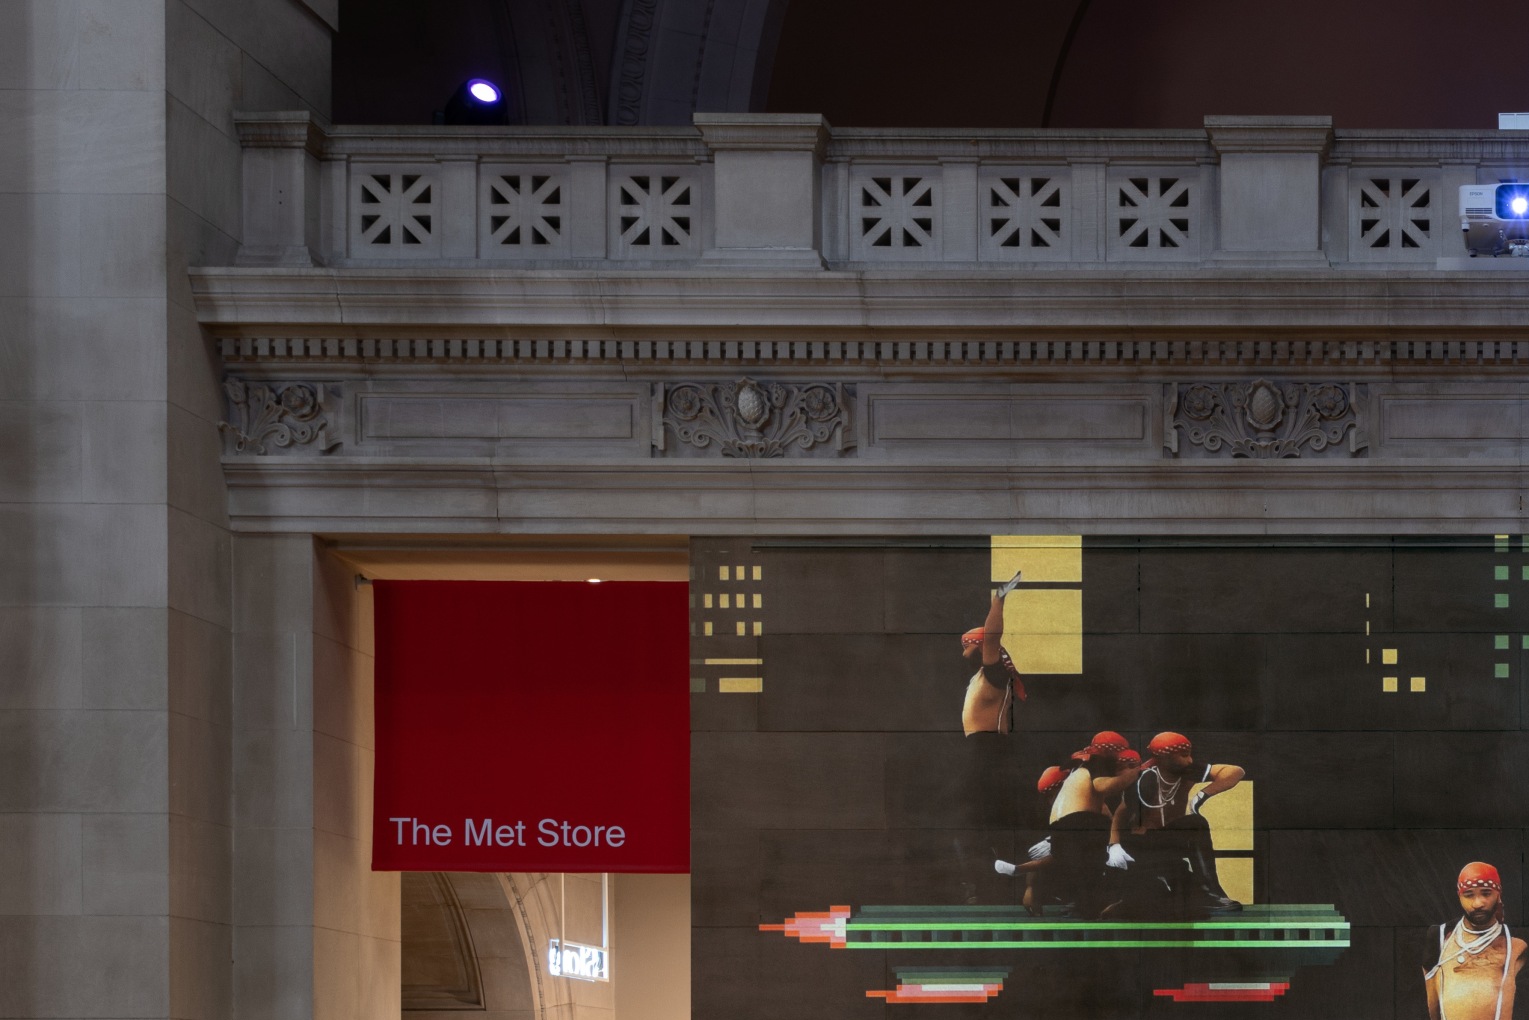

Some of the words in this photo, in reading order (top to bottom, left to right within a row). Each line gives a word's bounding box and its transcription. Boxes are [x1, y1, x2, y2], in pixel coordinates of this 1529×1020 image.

[389, 816, 452, 846] The
[465, 818, 526, 847] Met
[537, 818, 626, 848] Store
